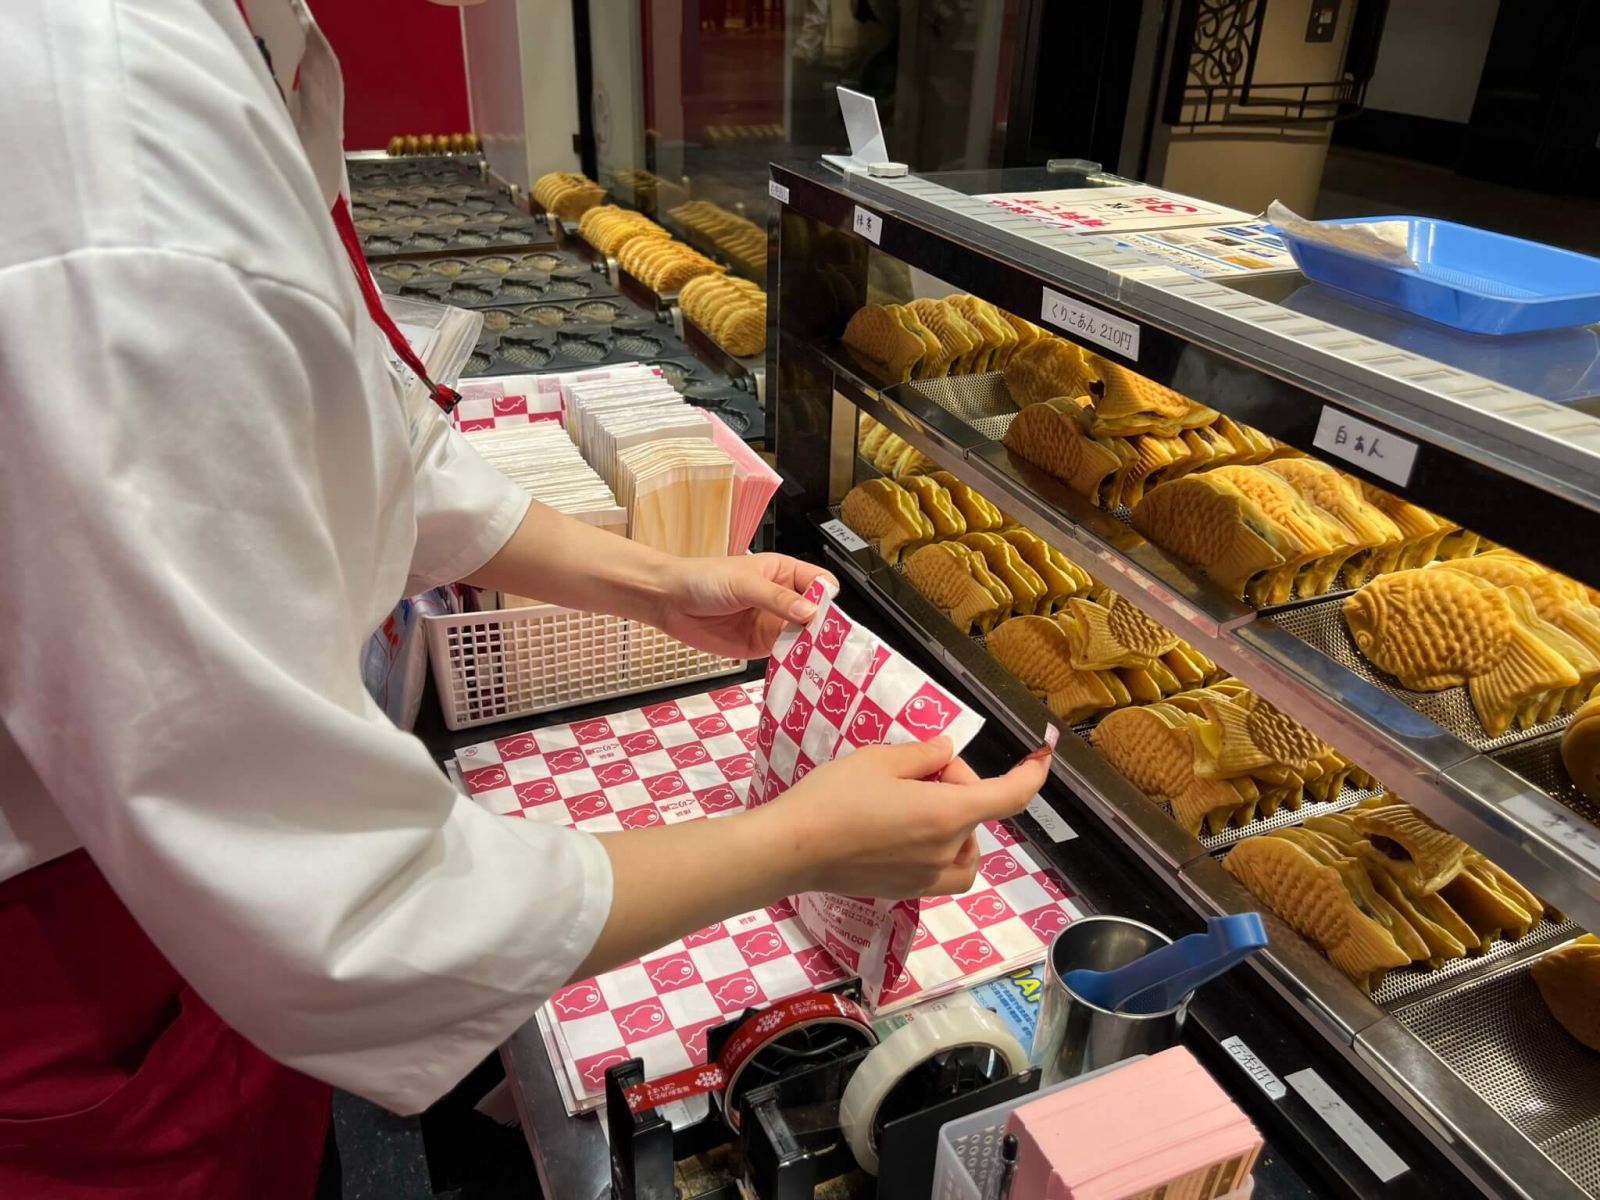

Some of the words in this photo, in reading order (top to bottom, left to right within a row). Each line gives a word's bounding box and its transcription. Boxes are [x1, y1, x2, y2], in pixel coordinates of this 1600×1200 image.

[1051, 303, 1097, 334] くりこあん
[1099, 323, 1132, 351] 210円
[1335, 425, 1385, 459] 白あん
[1228, 1041, 1277, 1093] 右先出し
